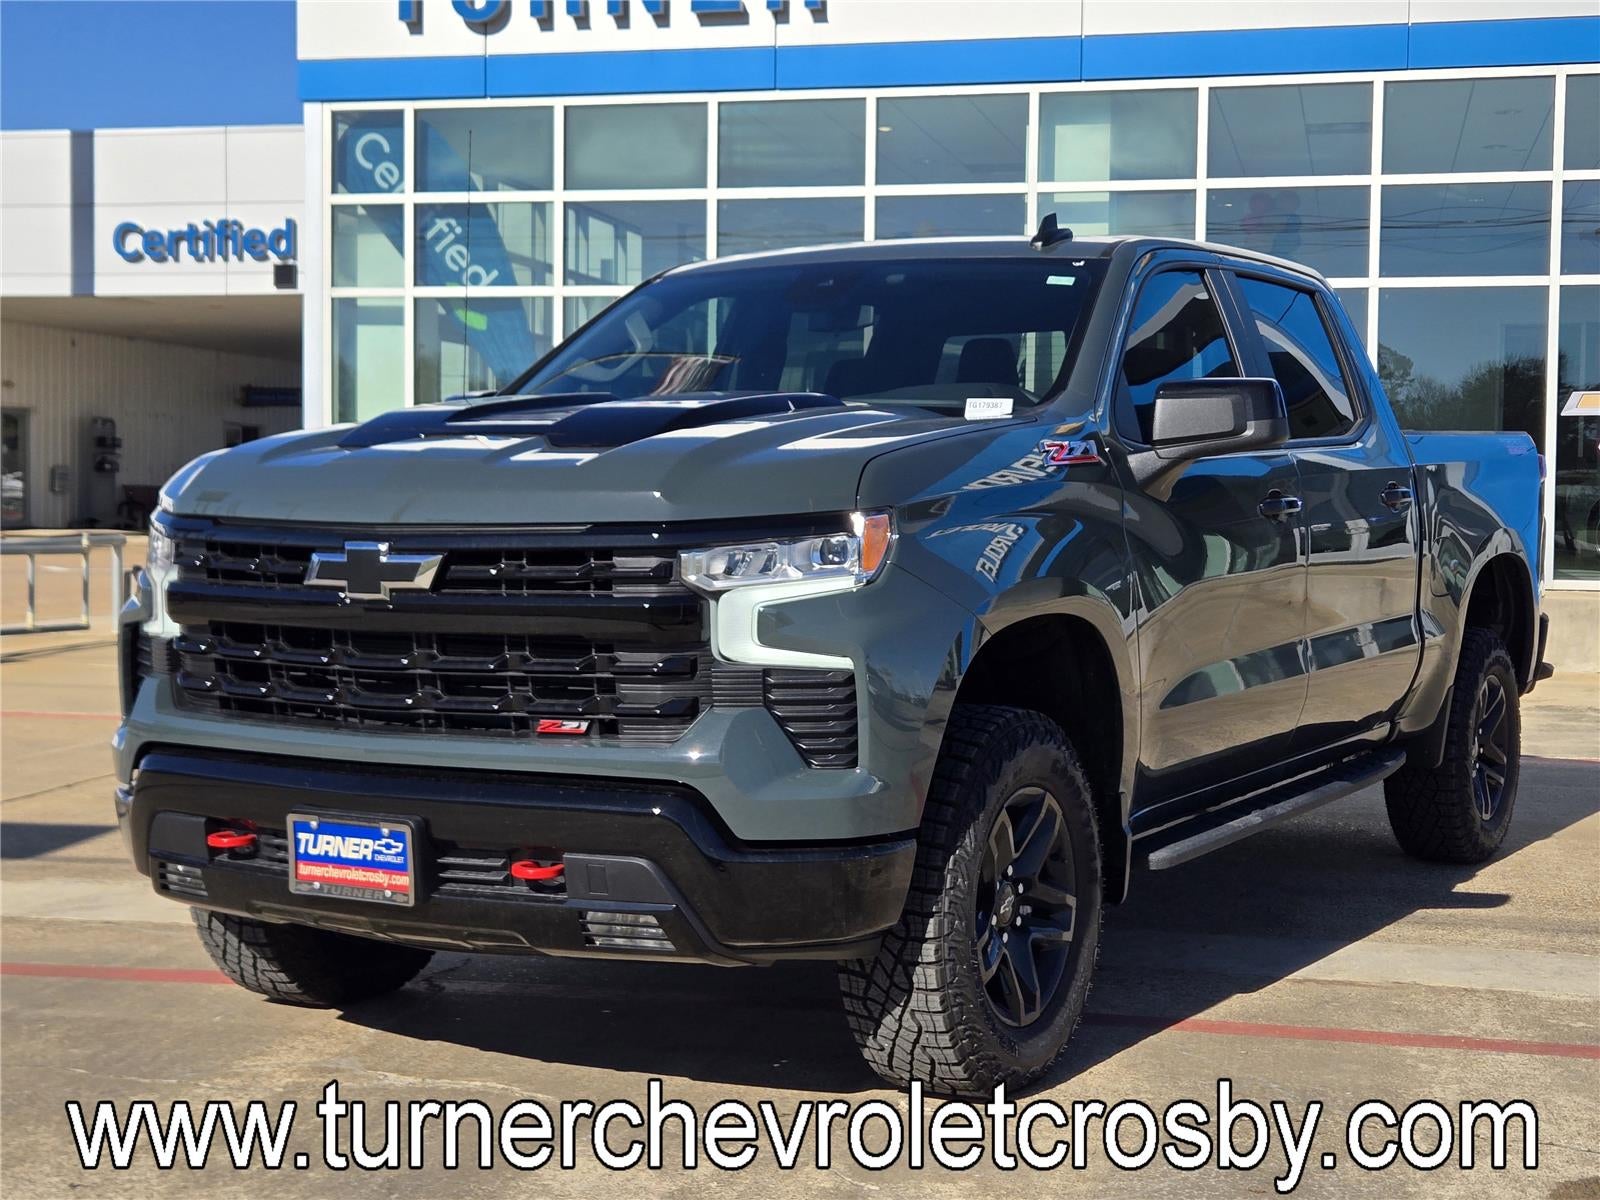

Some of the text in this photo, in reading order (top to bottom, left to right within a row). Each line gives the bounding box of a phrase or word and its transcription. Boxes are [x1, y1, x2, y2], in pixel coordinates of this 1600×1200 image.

[113, 217, 297, 263] Certified
[297, 832, 374, 860] TURNER
[297, 862, 410, 887] turnerchevroletcrosby.com
[322, 885, 385, 900] TURNER
